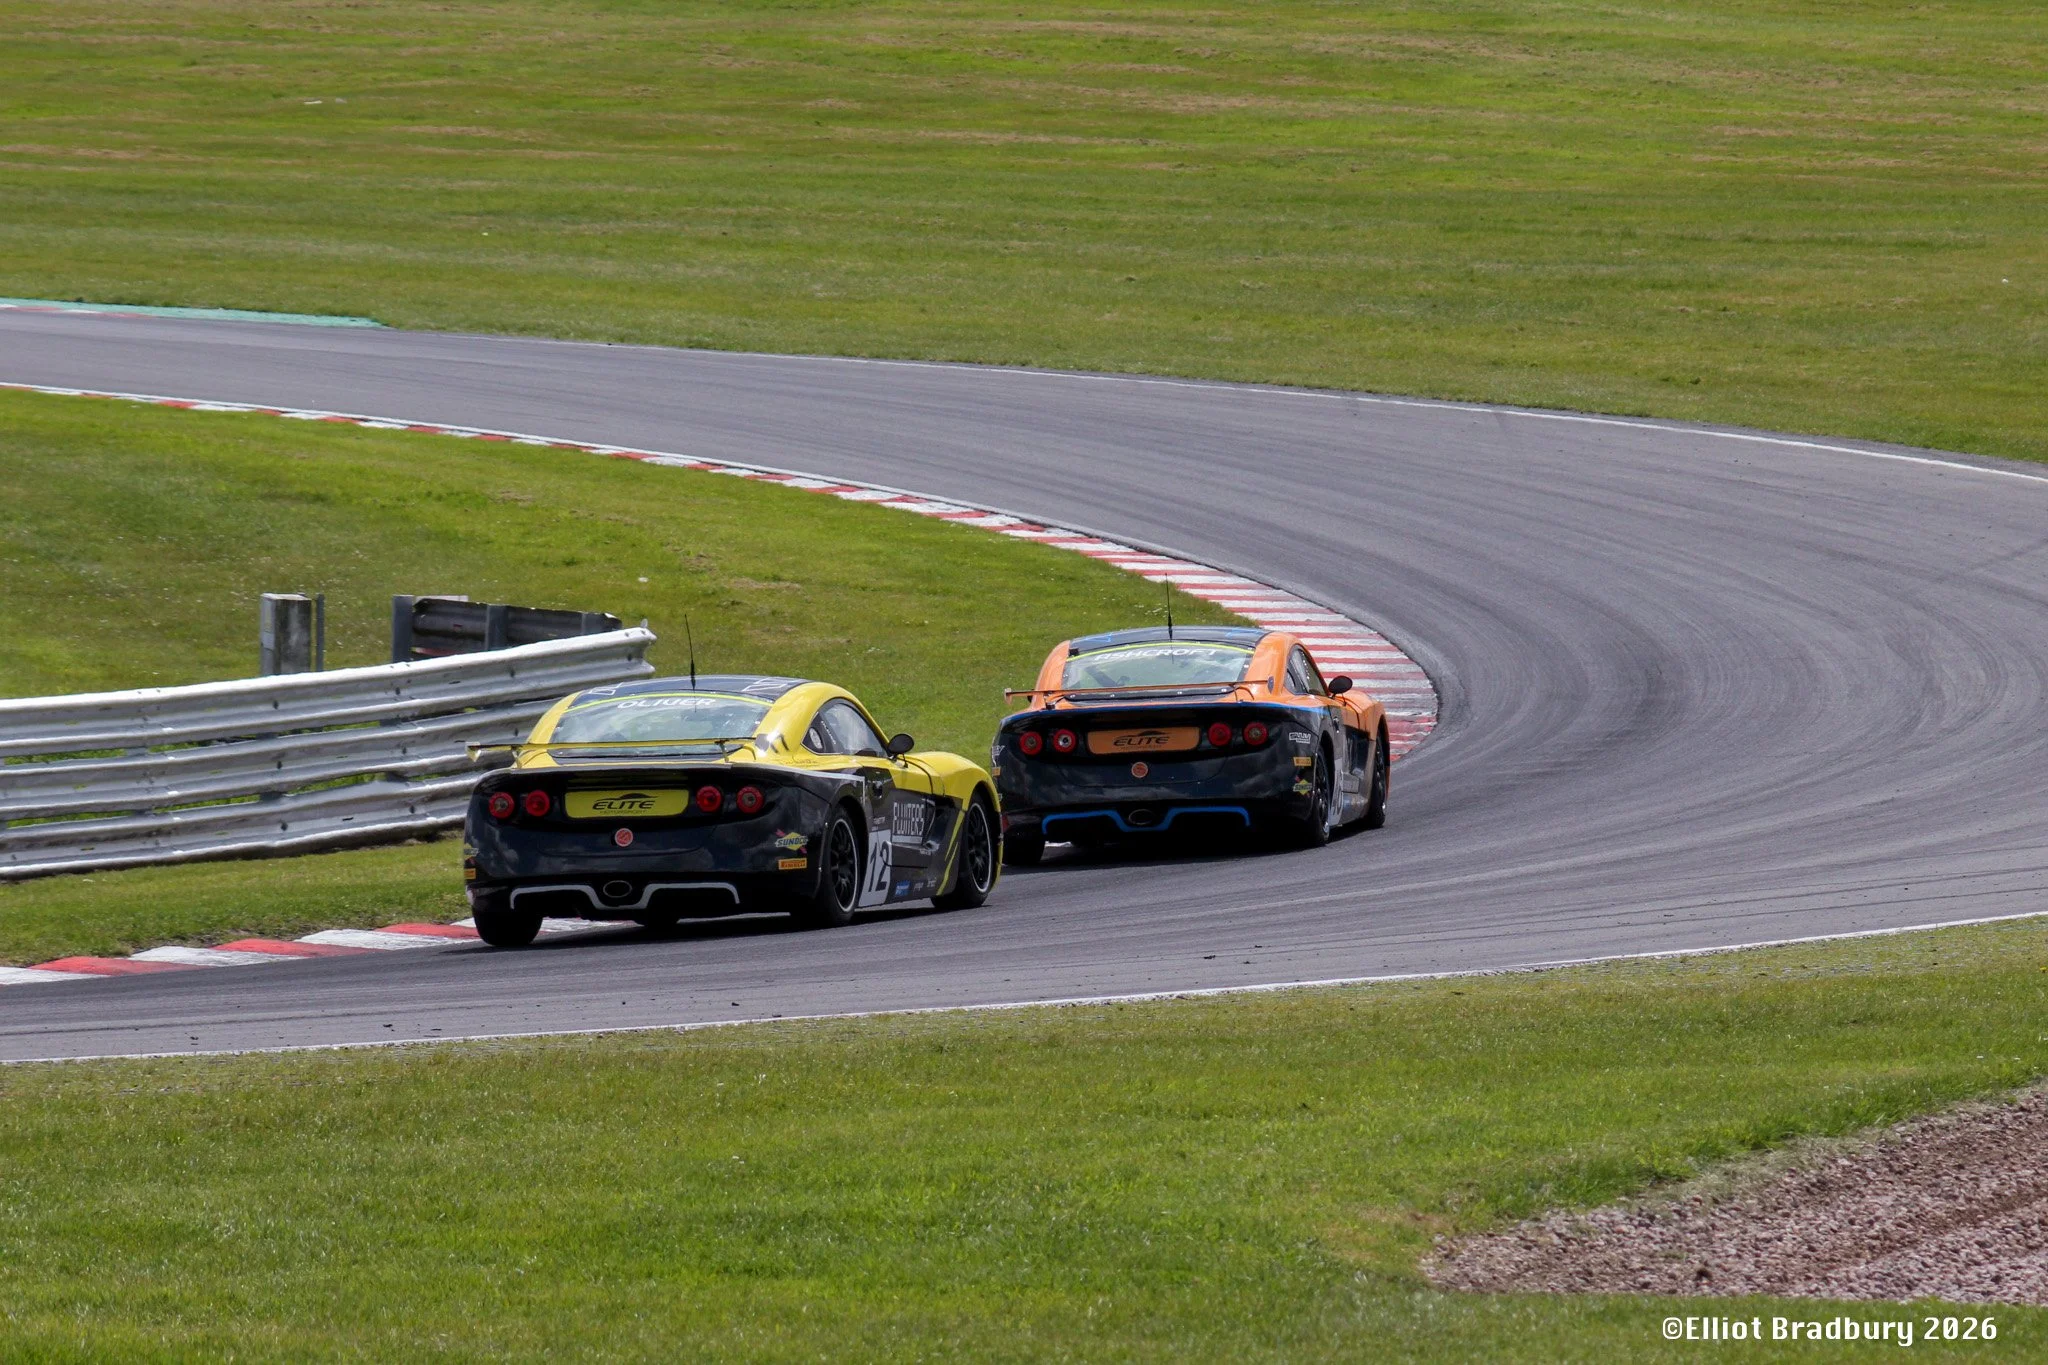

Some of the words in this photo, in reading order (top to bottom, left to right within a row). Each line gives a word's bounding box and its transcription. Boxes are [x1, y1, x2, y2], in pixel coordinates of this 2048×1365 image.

[1094, 648, 1218, 661] ASHCROFT
[617, 697, 716, 709] OLIVER
[1113, 736, 1170, 747] ELITE
[592, 800, 655, 810] ELITE
[867, 841, 890, 893] 12
